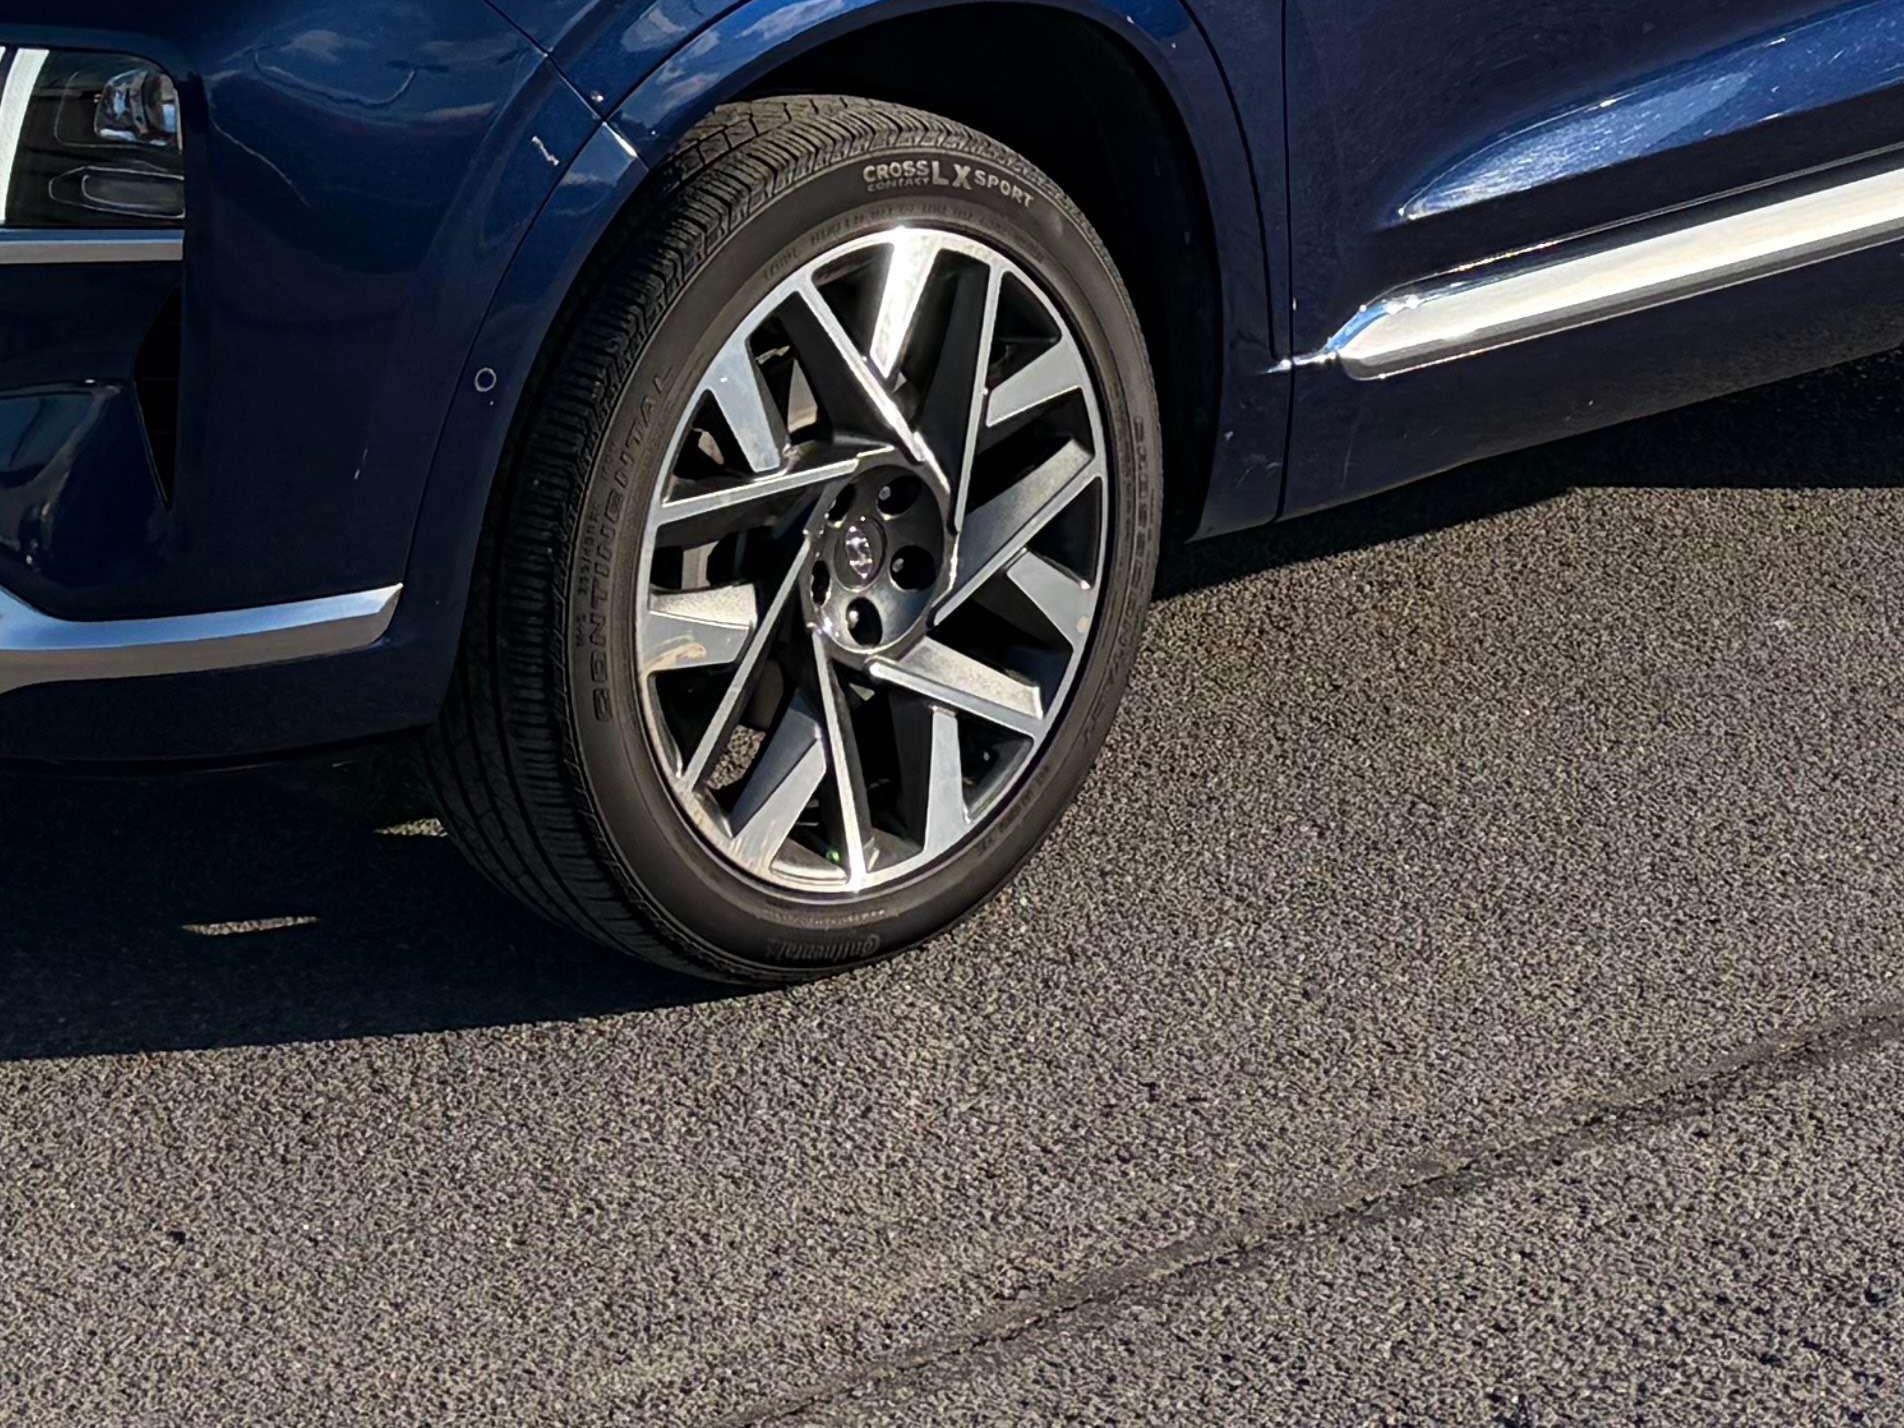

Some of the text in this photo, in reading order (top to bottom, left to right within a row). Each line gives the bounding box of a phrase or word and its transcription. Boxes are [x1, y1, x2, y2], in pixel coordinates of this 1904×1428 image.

[862, 159, 930, 183] CROSS
[867, 176, 930, 192] CONTACT
[973, 169, 1035, 208] SPORT
